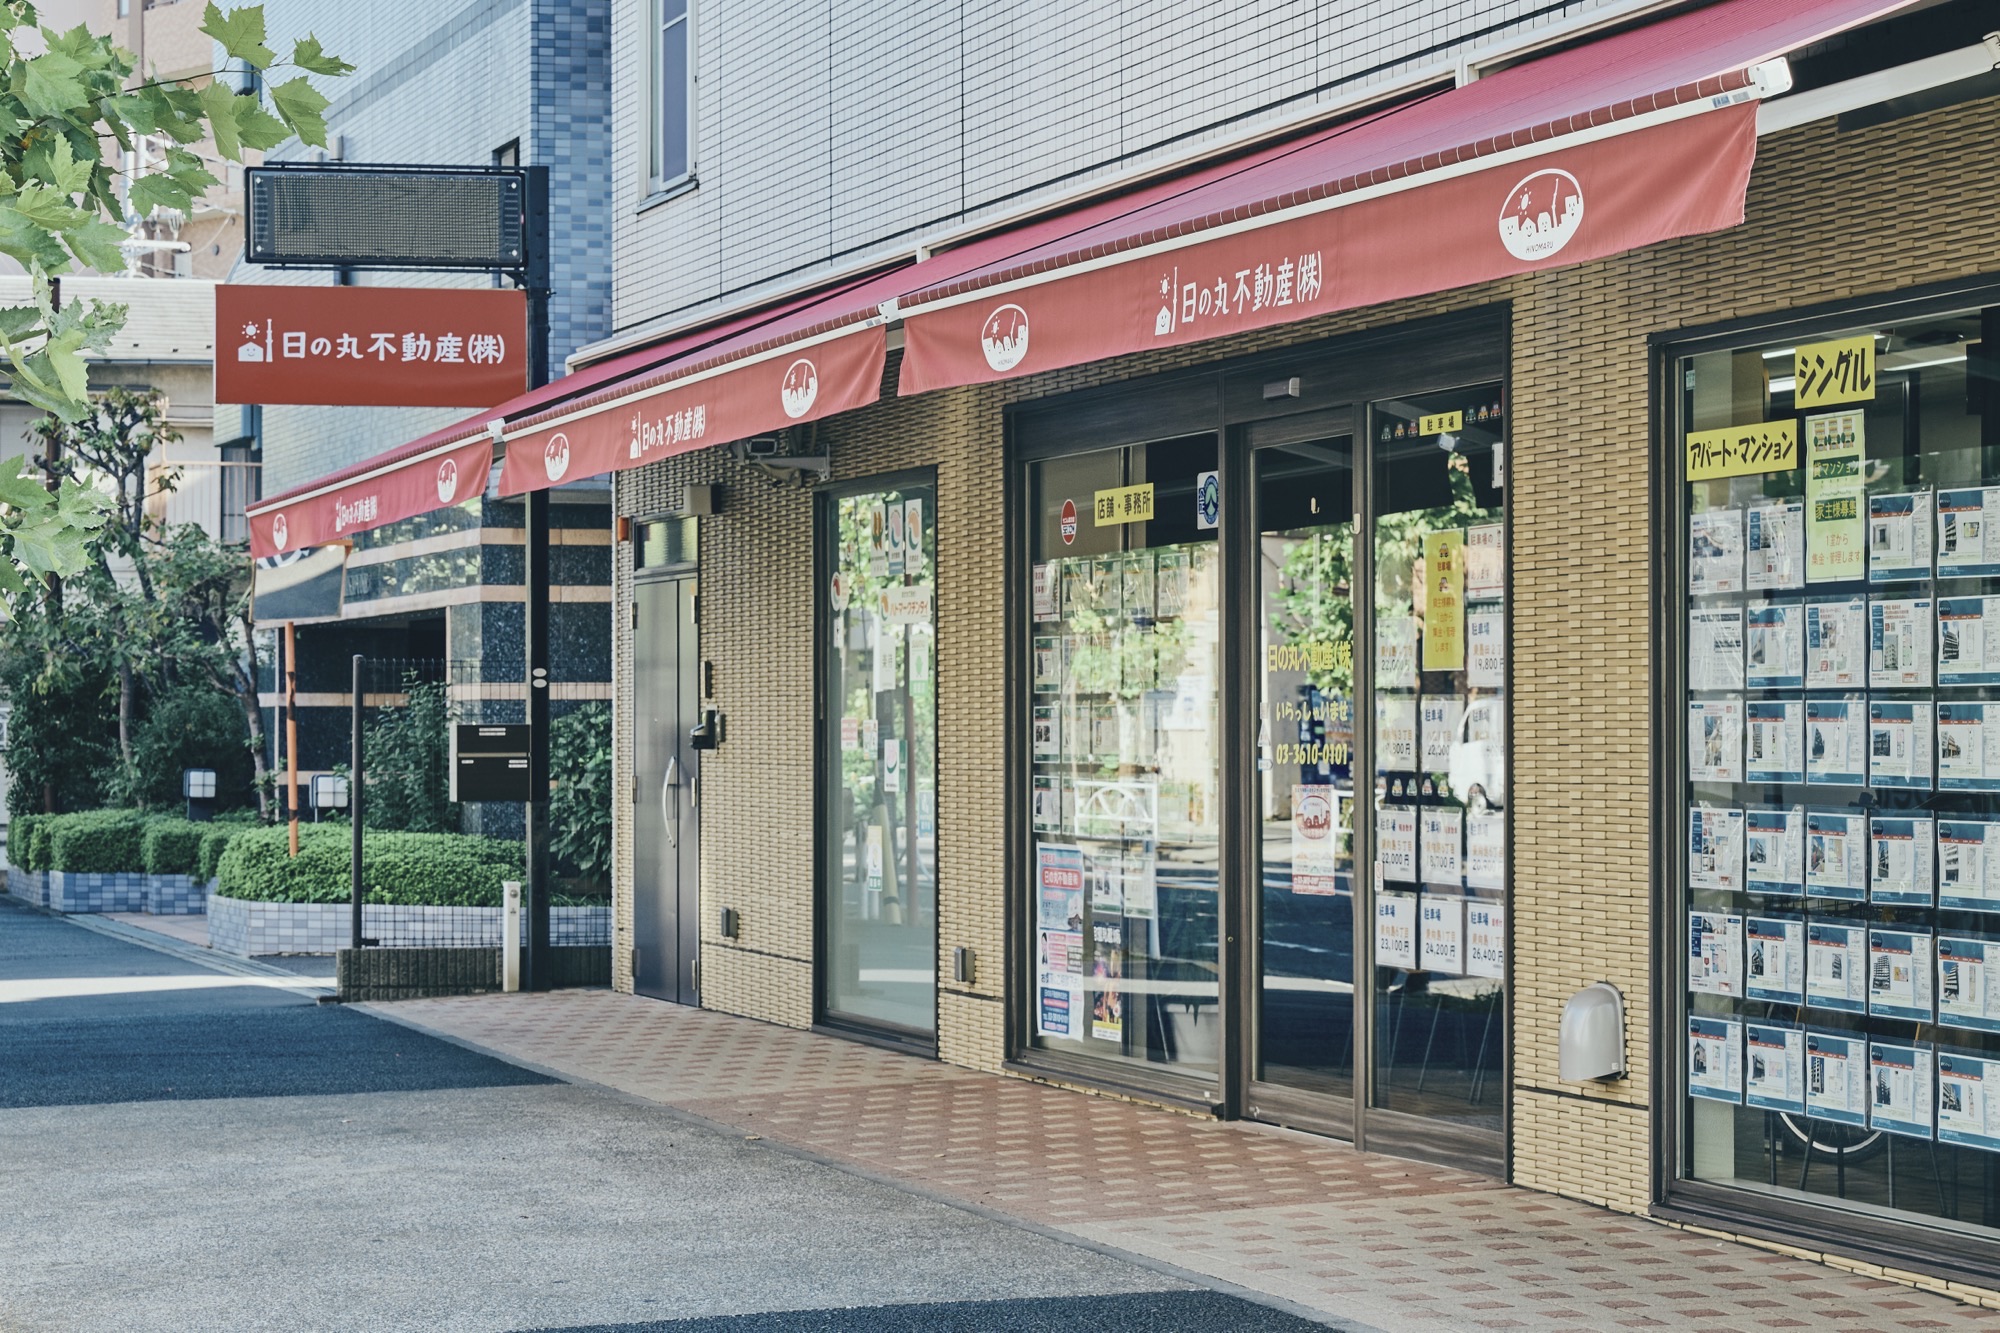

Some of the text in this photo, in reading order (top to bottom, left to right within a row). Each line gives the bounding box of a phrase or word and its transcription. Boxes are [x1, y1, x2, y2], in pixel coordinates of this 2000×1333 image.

[1181, 251, 1322, 324] 日の丸不動産(株)
[283, 332, 505, 364] 日の丸不動産(株)
[1799, 348, 1871, 400] シングル
[1427, 416, 1455, 432] 駐車場
[1690, 431, 1793, 470] アパート・マンション
[1097, 491, 1151, 520] 店舗・事務所
[1815, 500, 1857, 520] 家主様募集
[1471, 622, 1489, 636] 駐車場
[1276, 701, 1348, 722] いらっしゃいませ
[1425, 709, 1443, 722] 駐車場
[1276, 743, 1348, 765] 03-3610-0101
[1379, 904, 1396, 918] 駐車場
[1424, 907, 1441, 921] 駐車場
[1471, 911, 1489, 926] 駐車場
[1381, 938, 1409, 953] 23,100円
[1425, 942, 1455, 958] 24,200円
[1472, 947, 1504, 963] 26,400円
